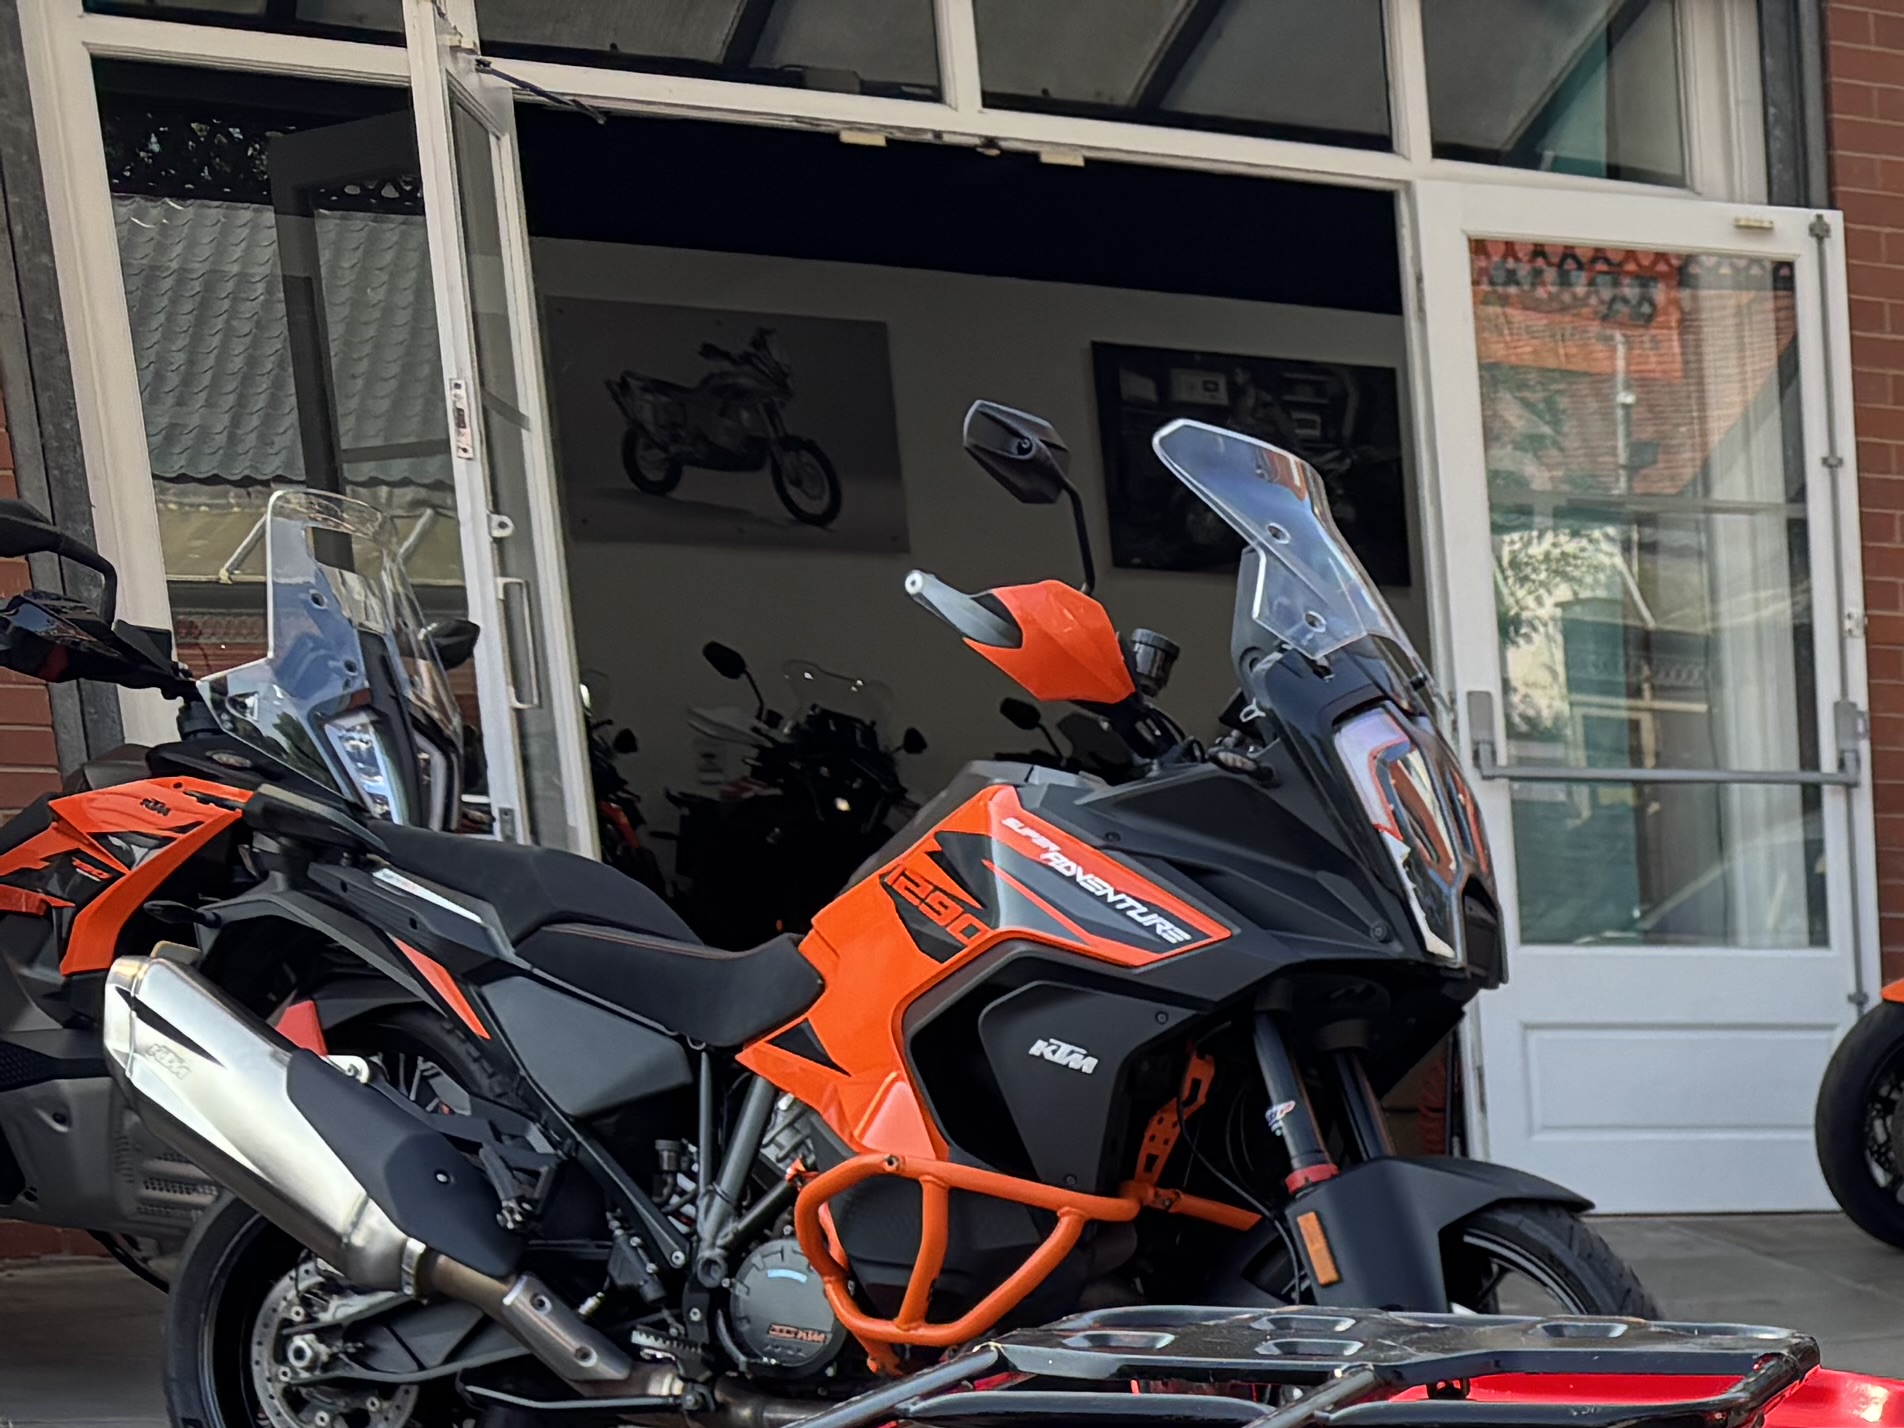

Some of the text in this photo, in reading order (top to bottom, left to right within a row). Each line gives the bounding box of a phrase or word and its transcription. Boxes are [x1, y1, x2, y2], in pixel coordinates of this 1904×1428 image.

[140, 797, 172, 817] KTM
[1001, 817, 1062, 853] SUPER
[885, 864, 991, 947] 1290
[1039, 850, 1192, 944] ADVENTURE
[1028, 1037, 1099, 1075] KTM
